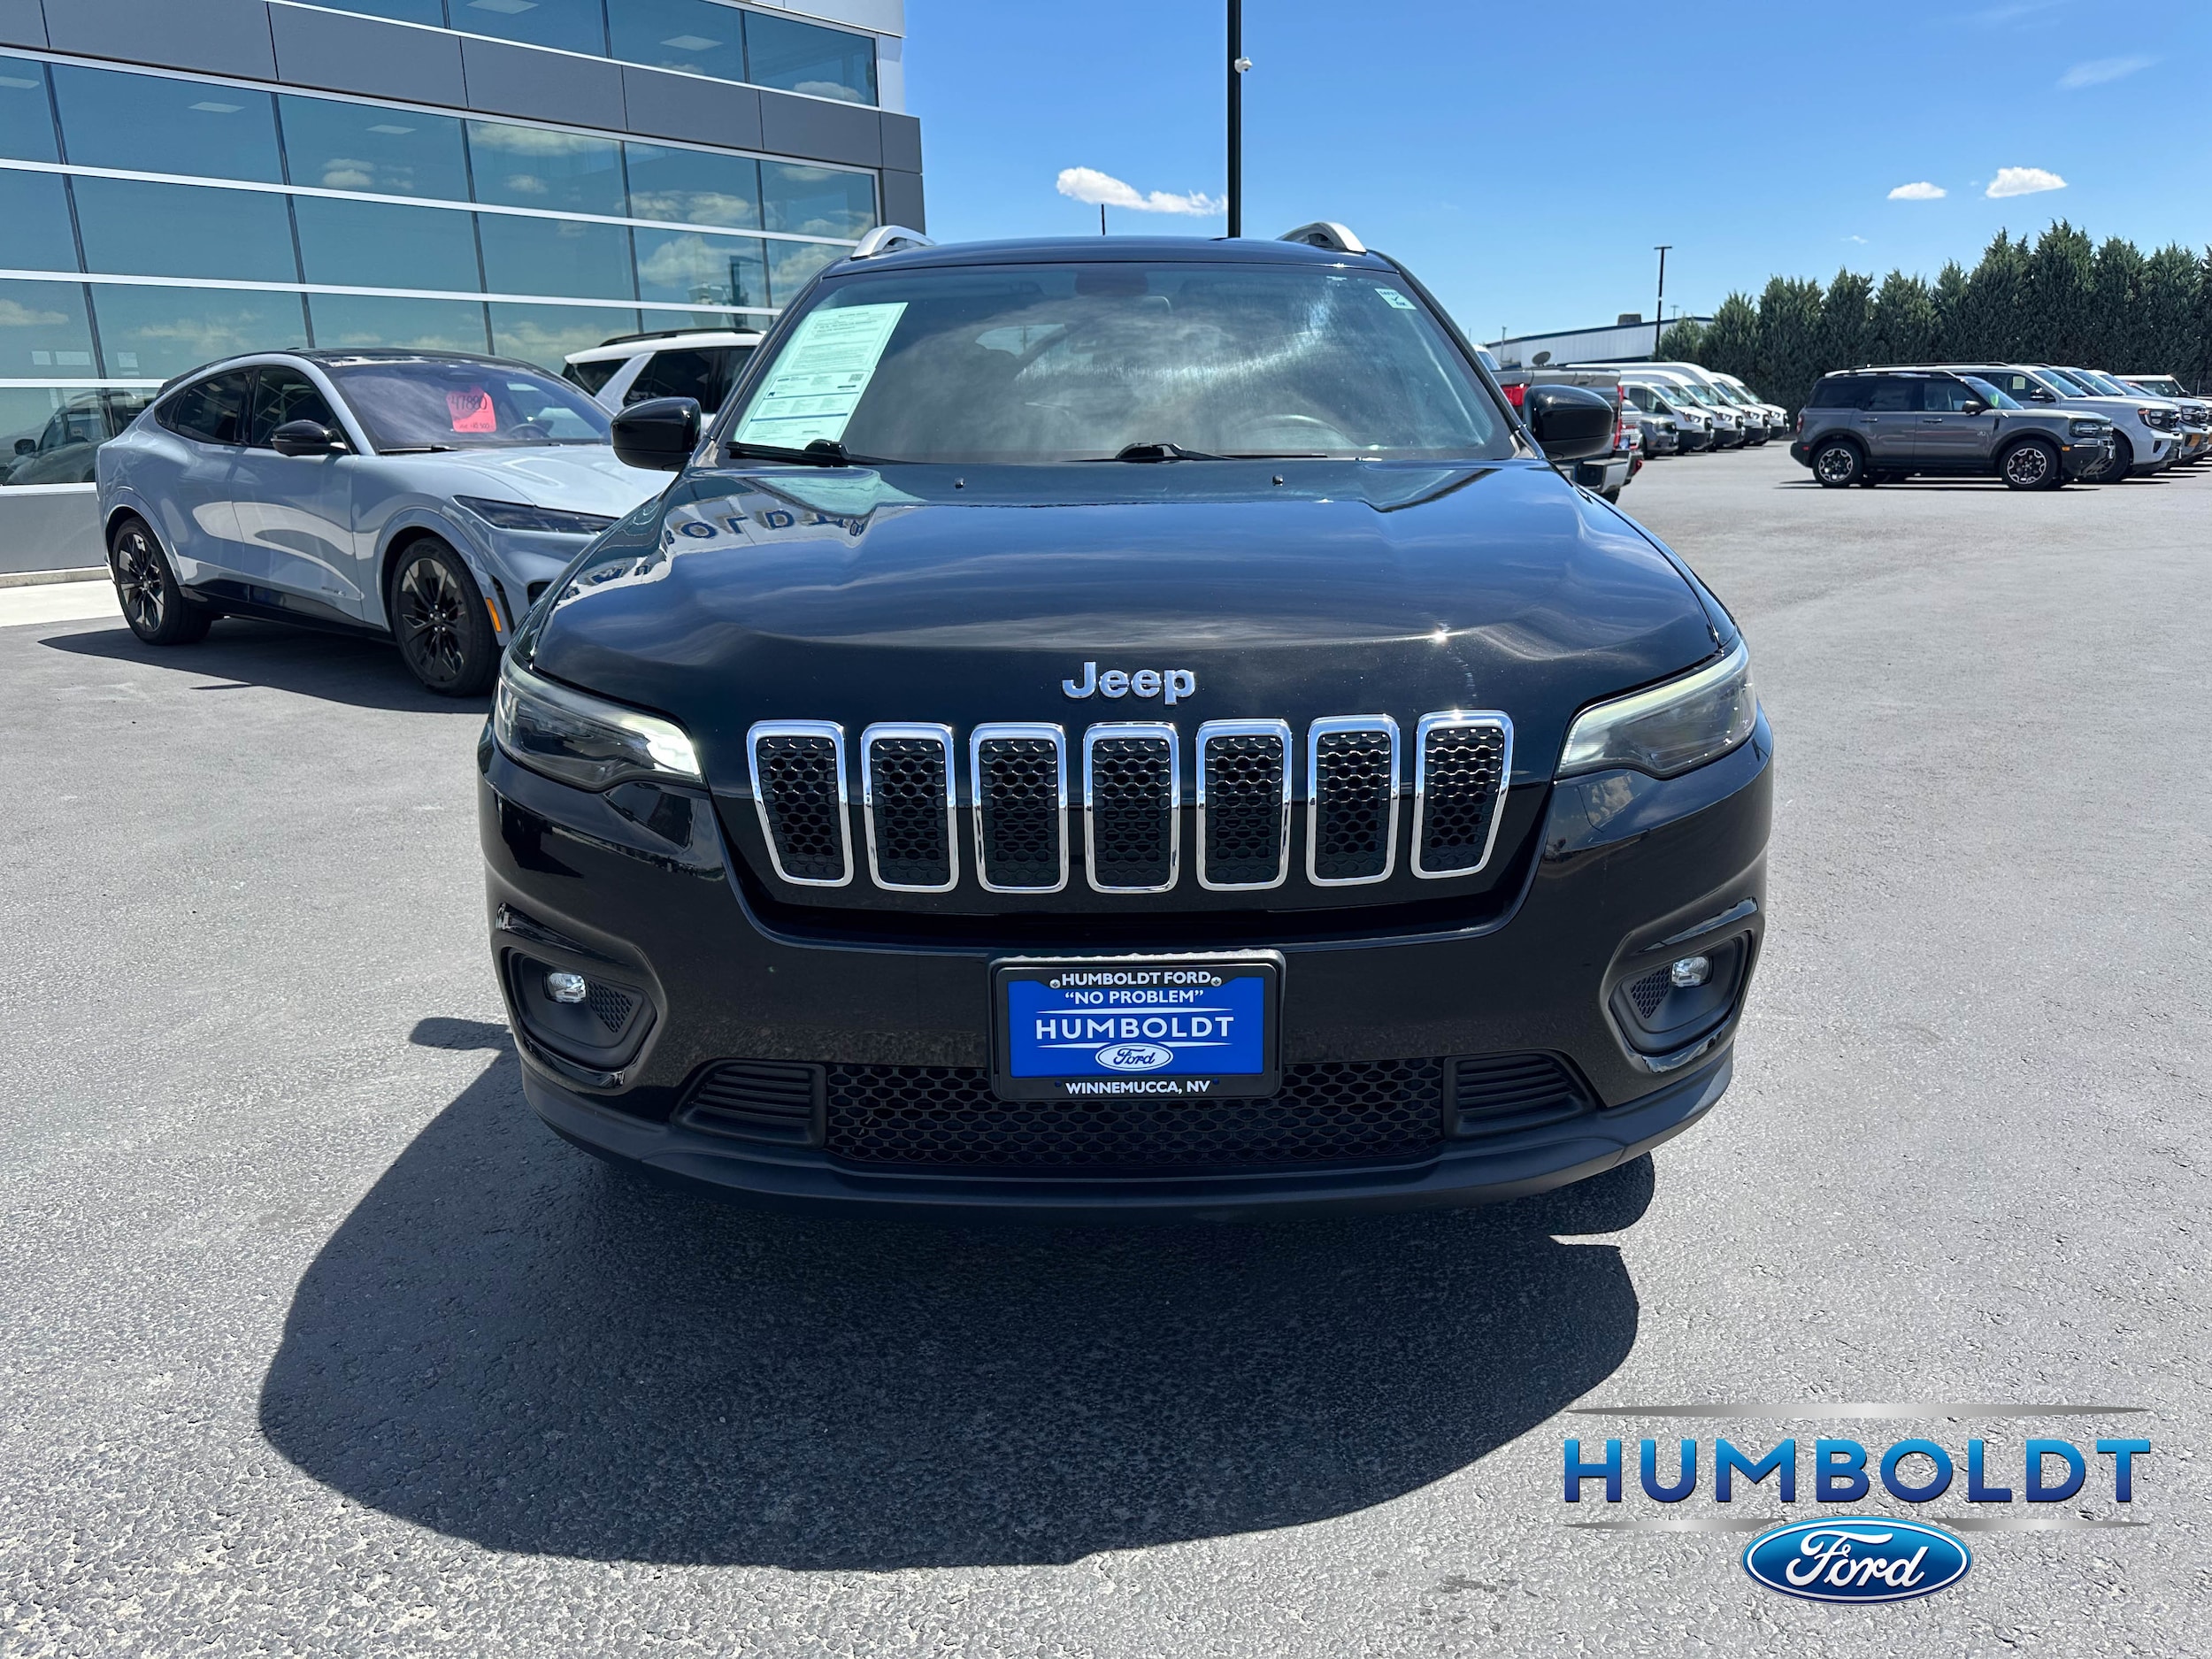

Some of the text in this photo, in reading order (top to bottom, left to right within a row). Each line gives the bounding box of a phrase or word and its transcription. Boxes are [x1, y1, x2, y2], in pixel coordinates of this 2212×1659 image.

[1062, 662, 1195, 705] Jeep
[1062, 972, 1211, 986] HUMBOLDT FORD
[1036, 1017, 1234, 1040] HUMBOLDT
[1112, 1048, 1156, 1066] Ford
[1065, 1080, 1210, 1095] WINNEMUCCA, NV
